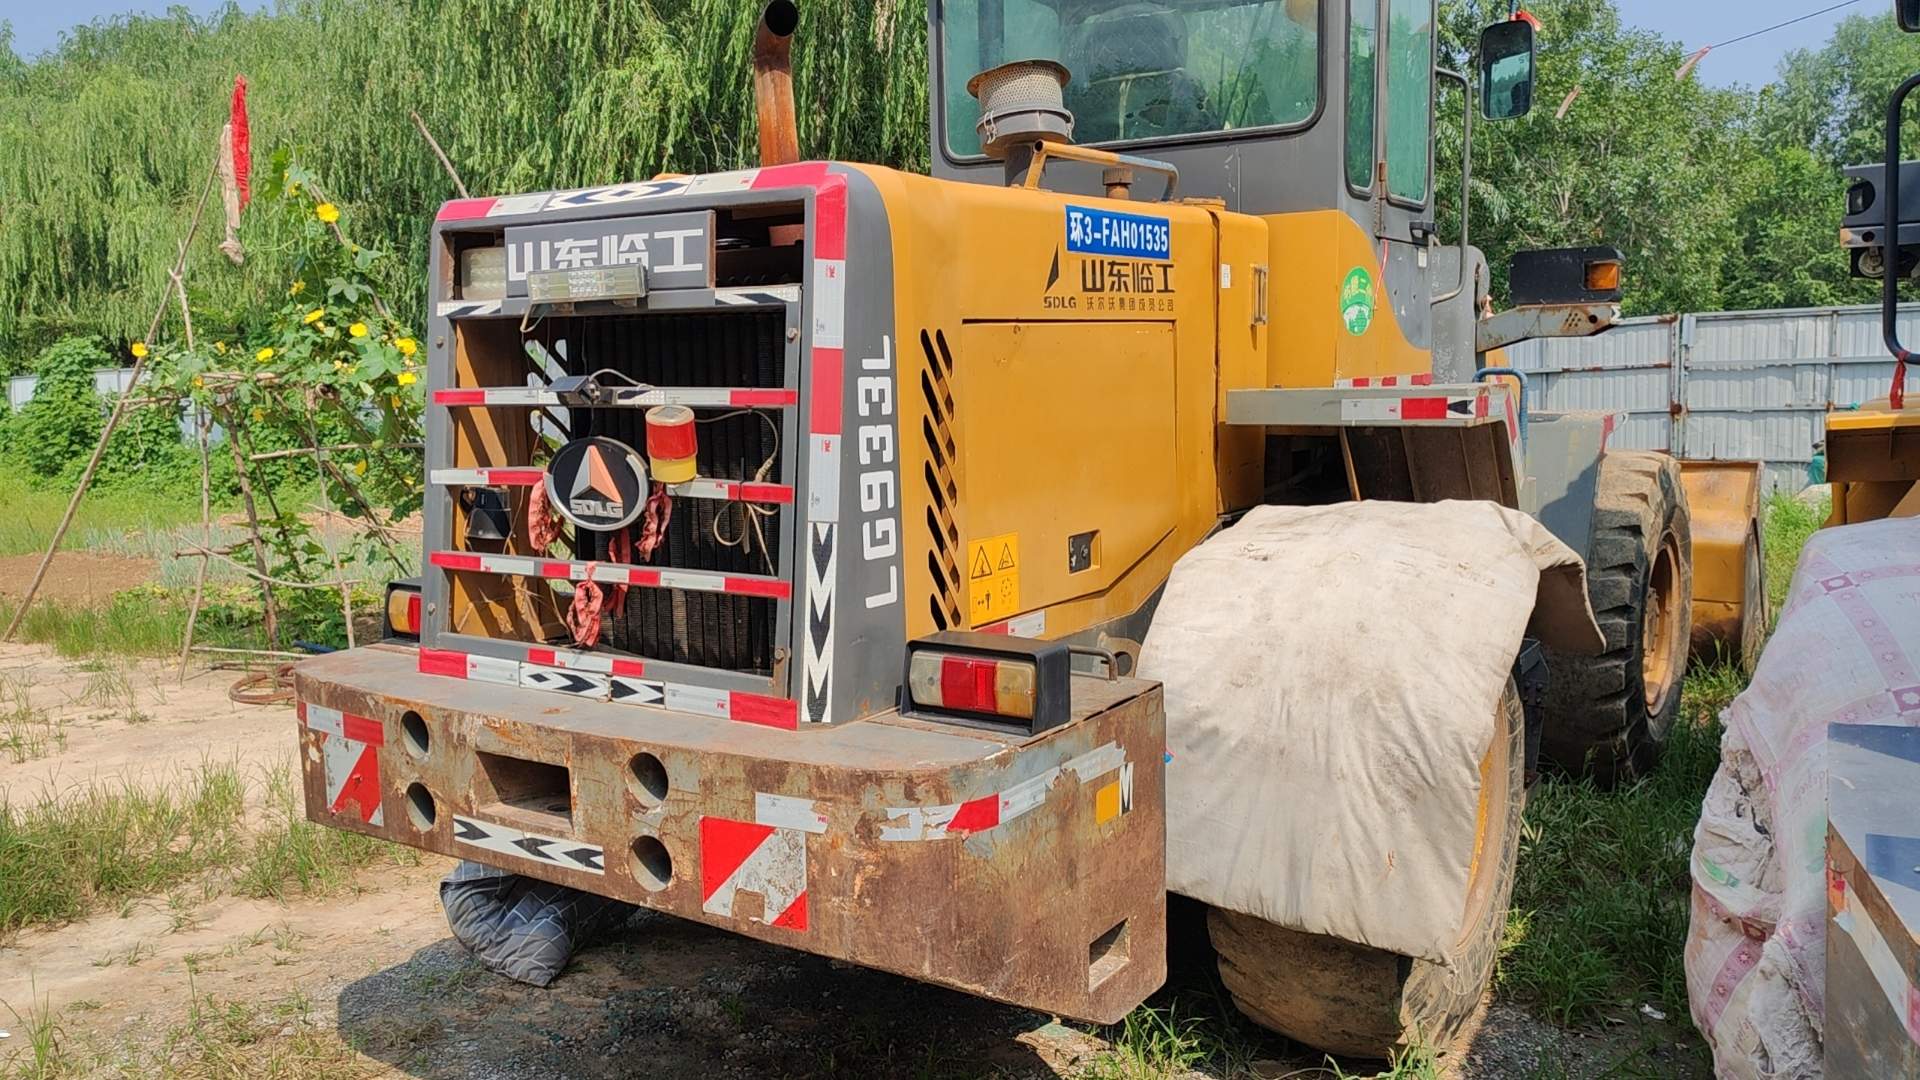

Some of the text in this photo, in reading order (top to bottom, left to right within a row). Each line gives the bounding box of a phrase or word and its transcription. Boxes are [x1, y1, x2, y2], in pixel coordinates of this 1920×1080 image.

[1069, 211, 1168, 252] 环3-FAH01535
[507, 228, 704, 282] 山东临工
[1081, 259, 1175, 294] 山东临工
[1043, 295, 1077, 309] SDLG
[857, 335, 897, 609] LG933L
[569, 499, 624, 520] SDLG
